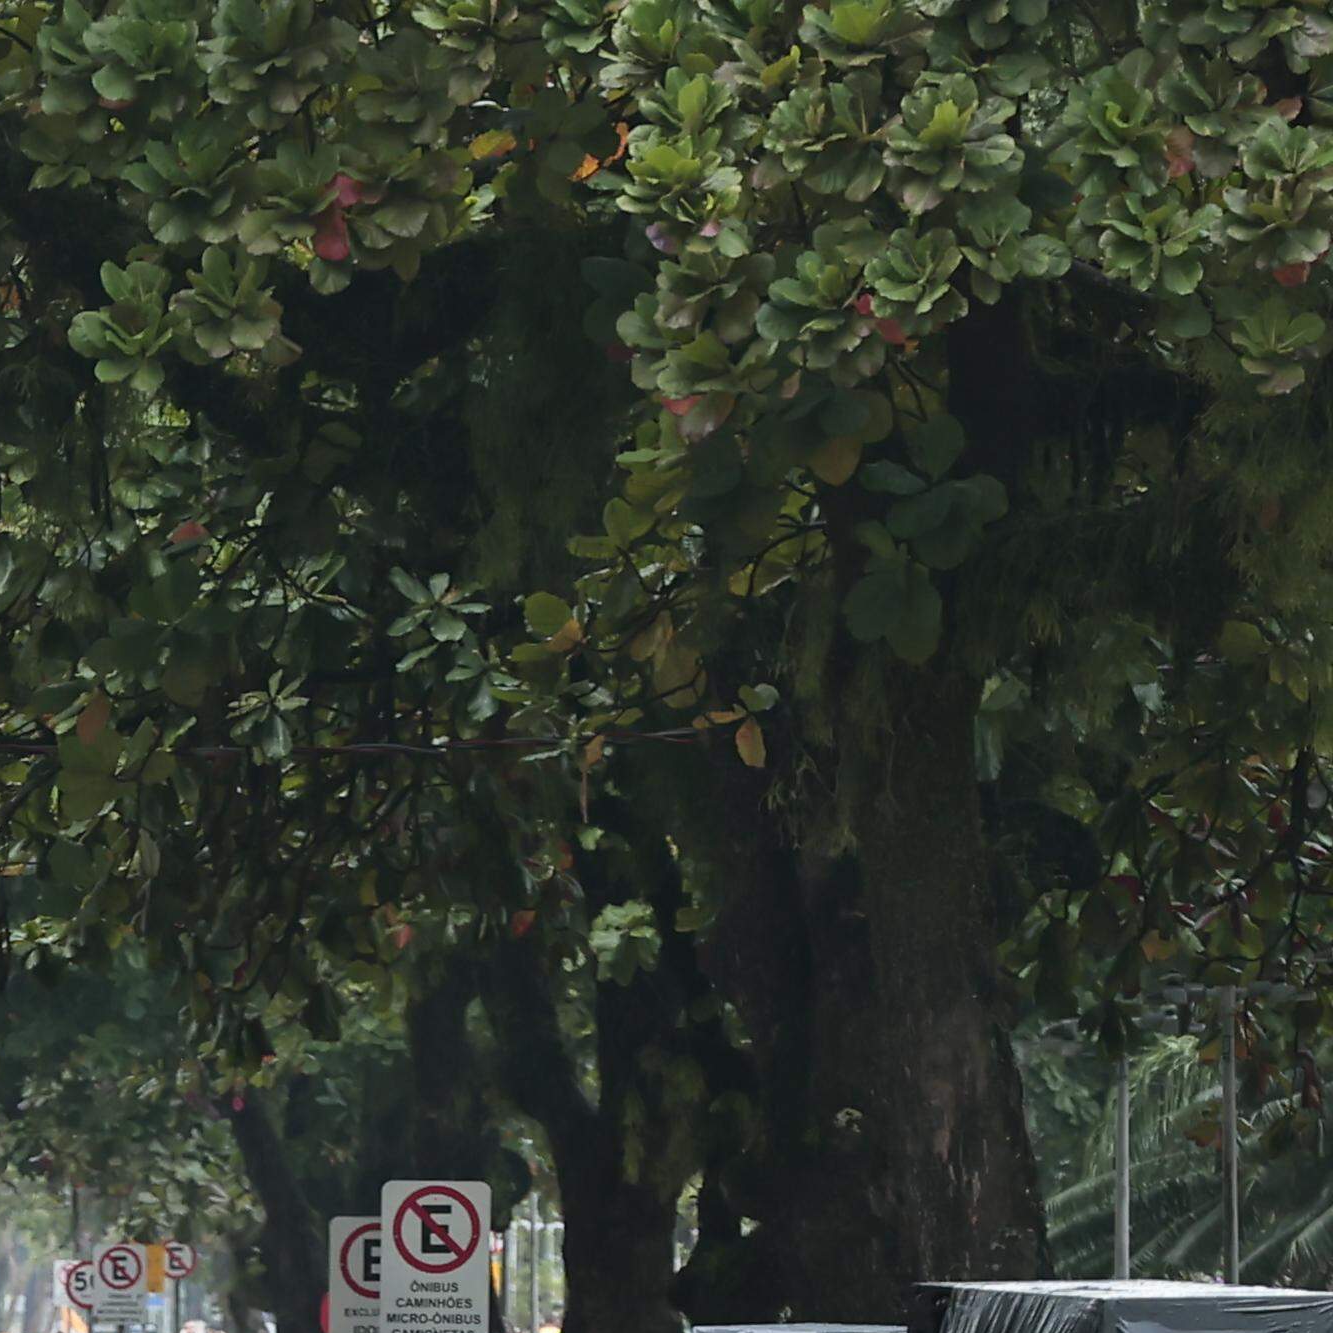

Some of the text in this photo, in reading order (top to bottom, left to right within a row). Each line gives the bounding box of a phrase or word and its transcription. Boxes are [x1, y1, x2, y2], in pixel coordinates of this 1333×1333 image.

[74, 1271, 95, 1291] 5
[410, 1279, 459, 1293] ÔNIBUS
[395, 1296, 473, 1309] CAMINHÕES
[386, 1311, 482, 1325] MICRO-ÔNIBUS
